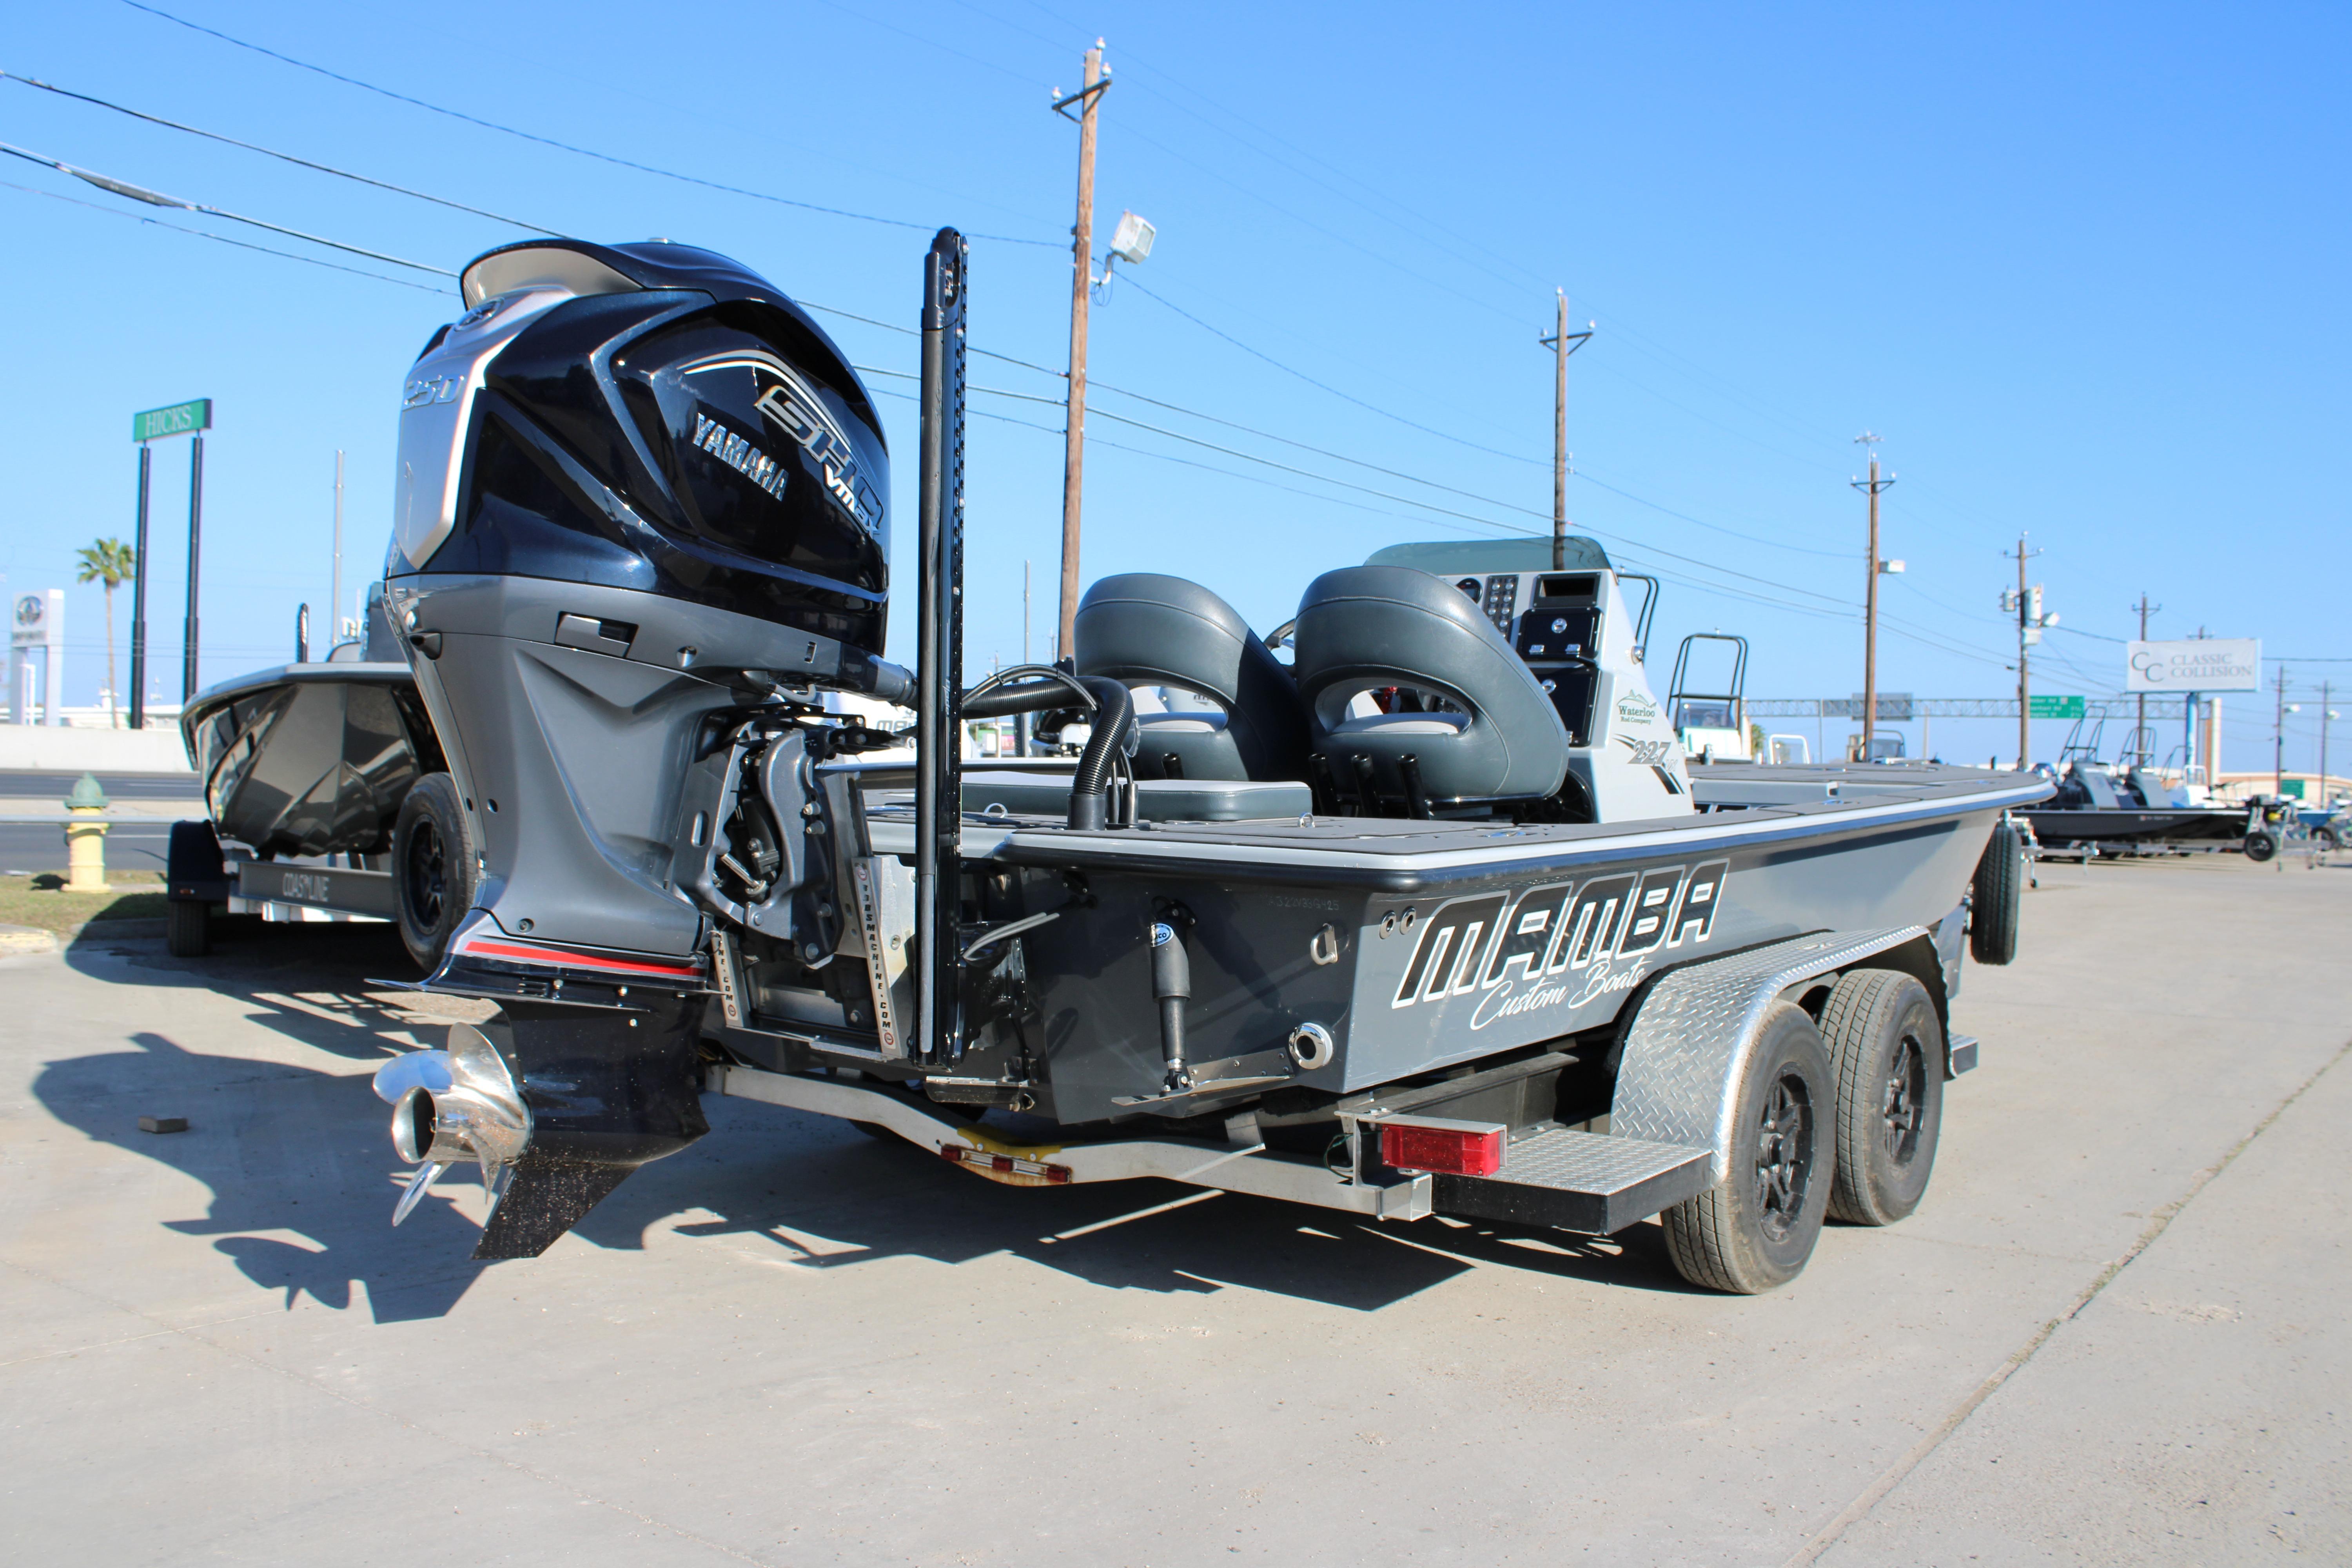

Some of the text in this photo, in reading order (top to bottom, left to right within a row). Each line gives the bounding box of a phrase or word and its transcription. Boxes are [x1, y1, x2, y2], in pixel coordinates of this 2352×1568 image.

[402, 374, 465, 412] 250
[145, 405, 191, 436] HICKS
[692, 413, 789, 502] YAMAHA
[2171, 653, 2232, 666] CLASSIC
[2171, 666, 2252, 678] COLLISION
[1619, 706, 1655, 717] Waterloo
[1627, 740, 1671, 765] 227
[1392, 858, 1730, 1009] MAMBA
[1470, 956, 1653, 1030] Custom Boats
